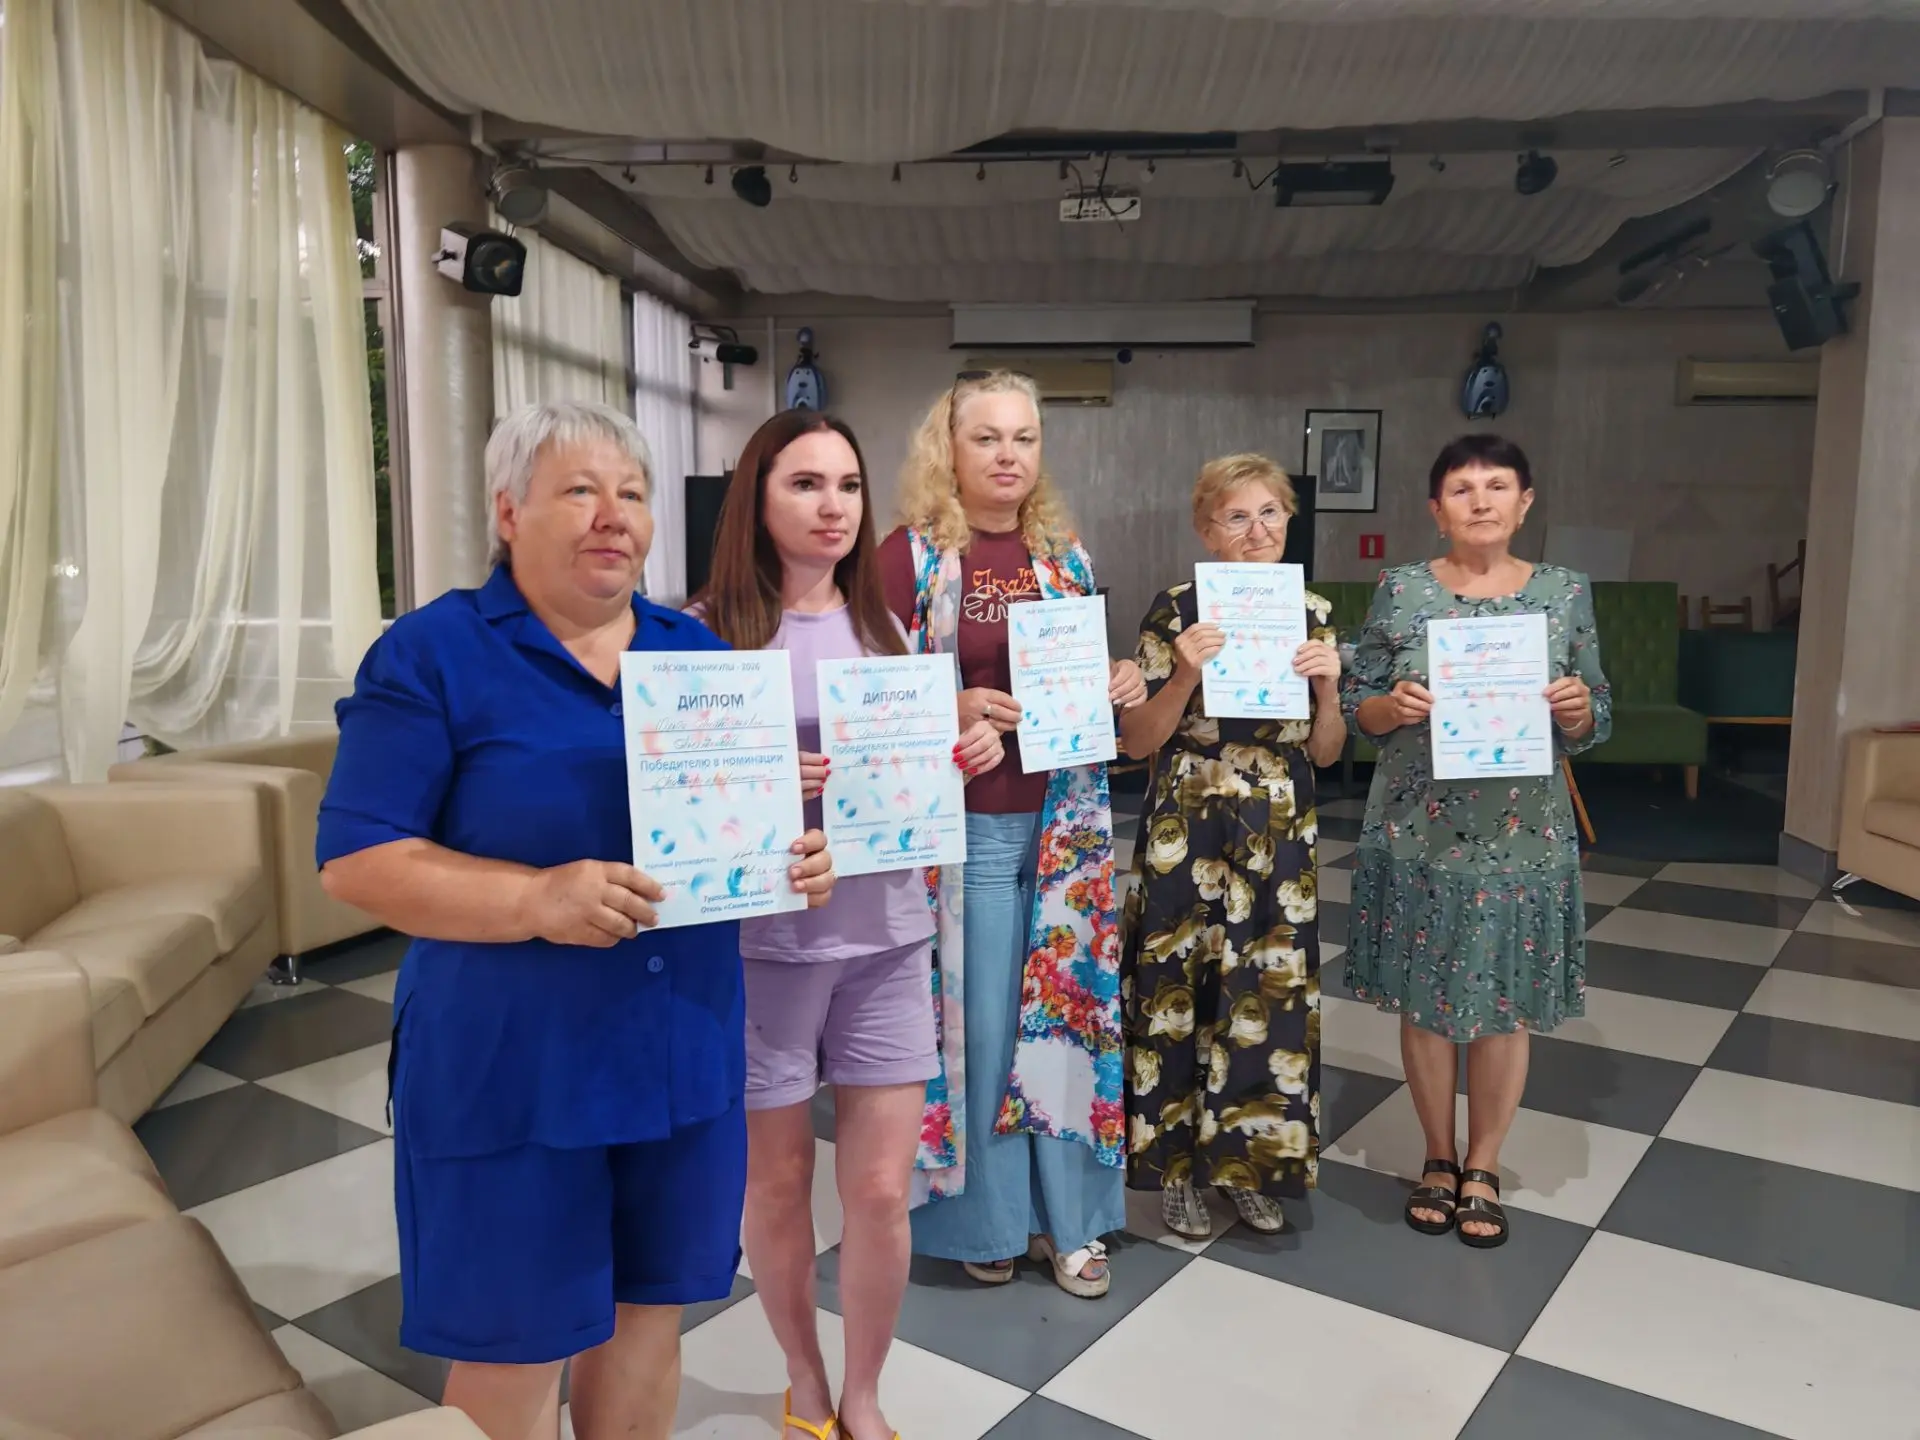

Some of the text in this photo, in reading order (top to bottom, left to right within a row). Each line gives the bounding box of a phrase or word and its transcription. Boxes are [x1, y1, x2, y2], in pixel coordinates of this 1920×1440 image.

[678, 693, 744, 711] ДИПЛОМ
[863, 689, 917, 706] ДИПЛОМ
[640, 754, 784, 772] Победителю в номинации
